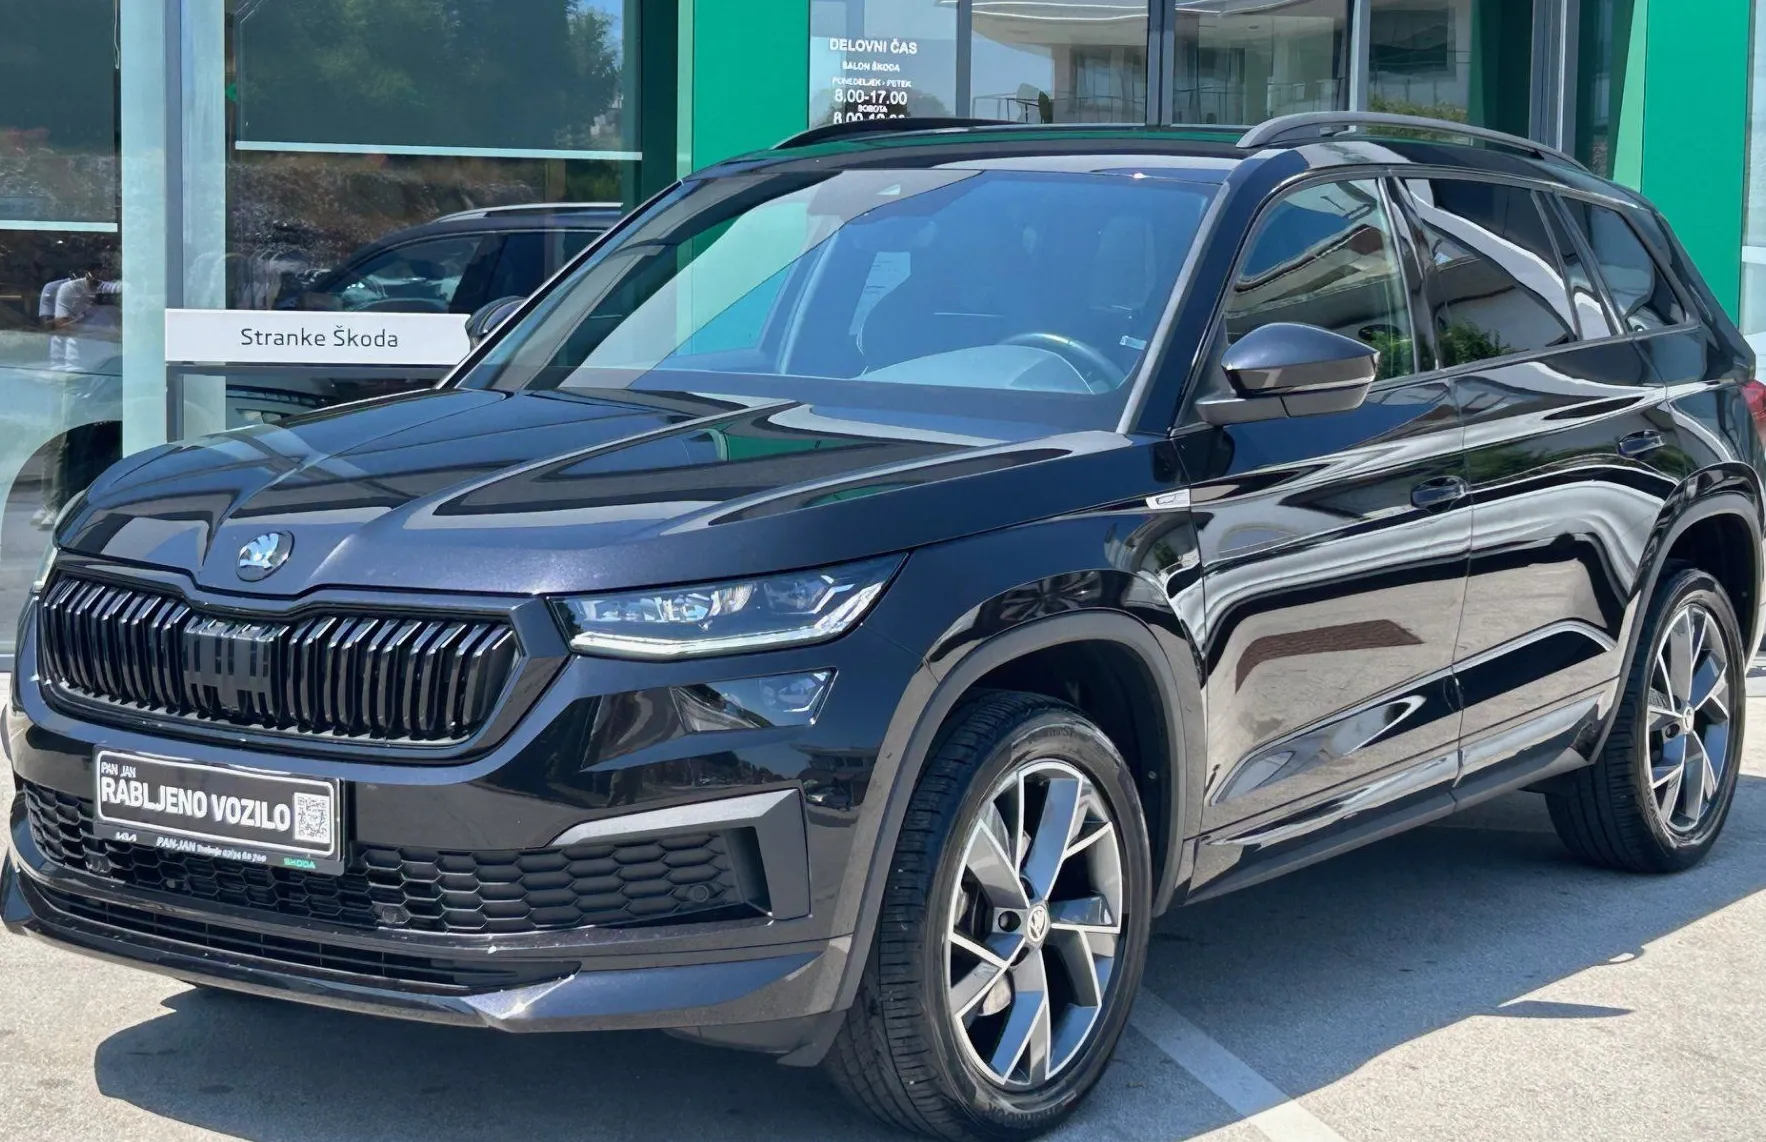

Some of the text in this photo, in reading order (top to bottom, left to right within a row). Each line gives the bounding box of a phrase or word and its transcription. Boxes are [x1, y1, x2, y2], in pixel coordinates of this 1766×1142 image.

[829, 38, 918, 54] DELOVNI ČAS
[842, 61, 900, 72] SALON ŠKODA
[834, 89, 908, 105] 8.00-17.00
[858, 104, 888, 113] SOBOTA
[241, 325, 399, 348] Stranke Škoda
[101, 761, 137, 778] PAN JAN
[101, 777, 291, 832] RABLJENO VOZILO
